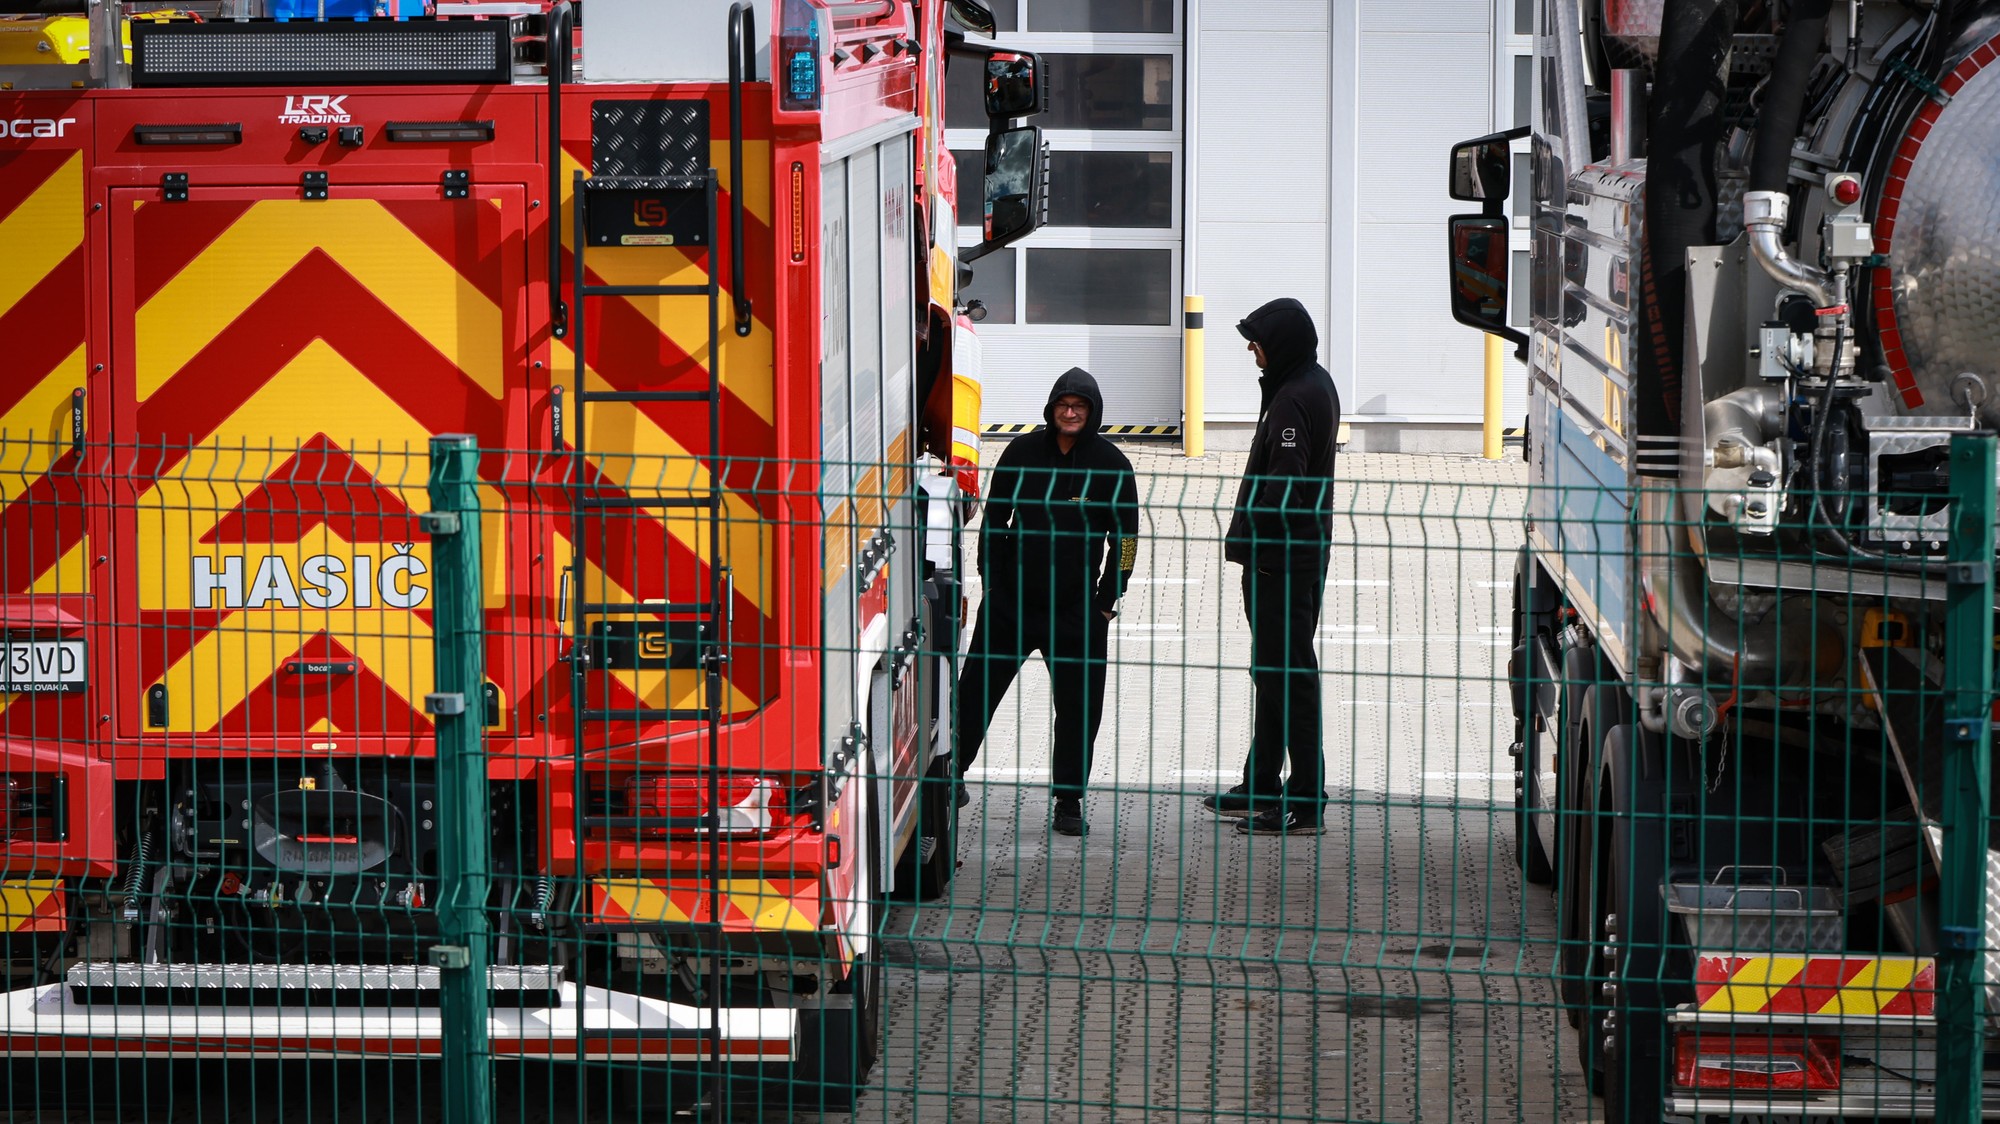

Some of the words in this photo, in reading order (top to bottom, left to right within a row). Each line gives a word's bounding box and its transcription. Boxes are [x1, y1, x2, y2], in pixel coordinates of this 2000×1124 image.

[284, 95, 348, 114] LRK
[278, 115, 351, 124] TRADING
[23, 684, 69, 692] SLOVAKA
